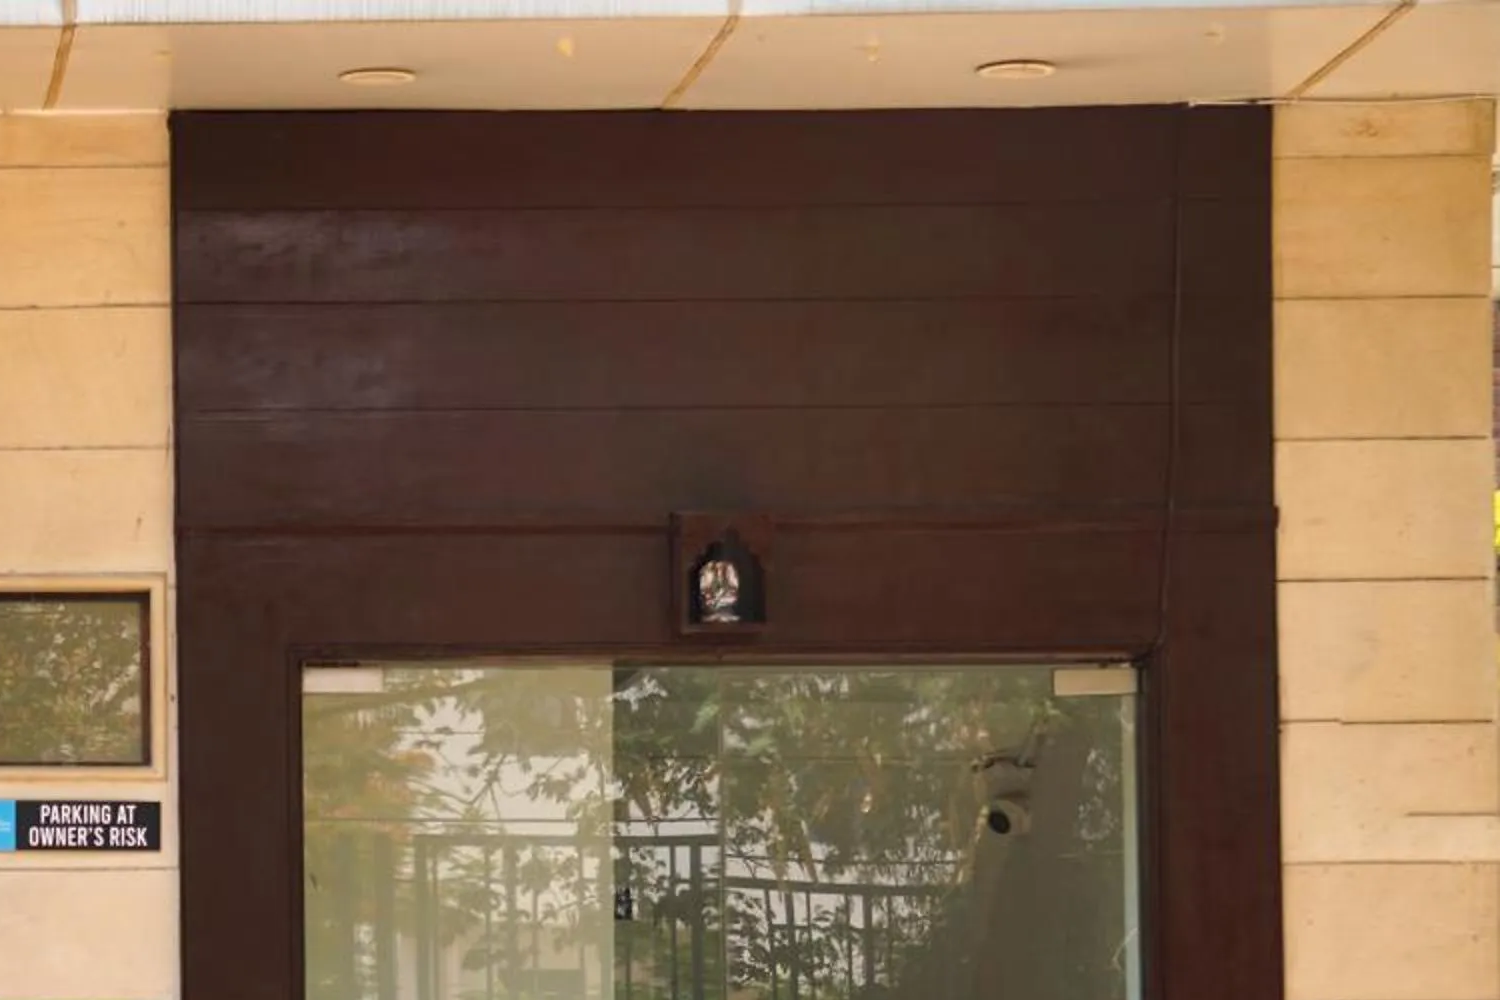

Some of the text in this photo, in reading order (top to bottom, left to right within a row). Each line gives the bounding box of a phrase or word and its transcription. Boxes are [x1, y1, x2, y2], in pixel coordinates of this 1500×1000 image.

[39, 804, 137, 825] PARKING AT
[29, 826, 148, 847] OWNER'S RISK
